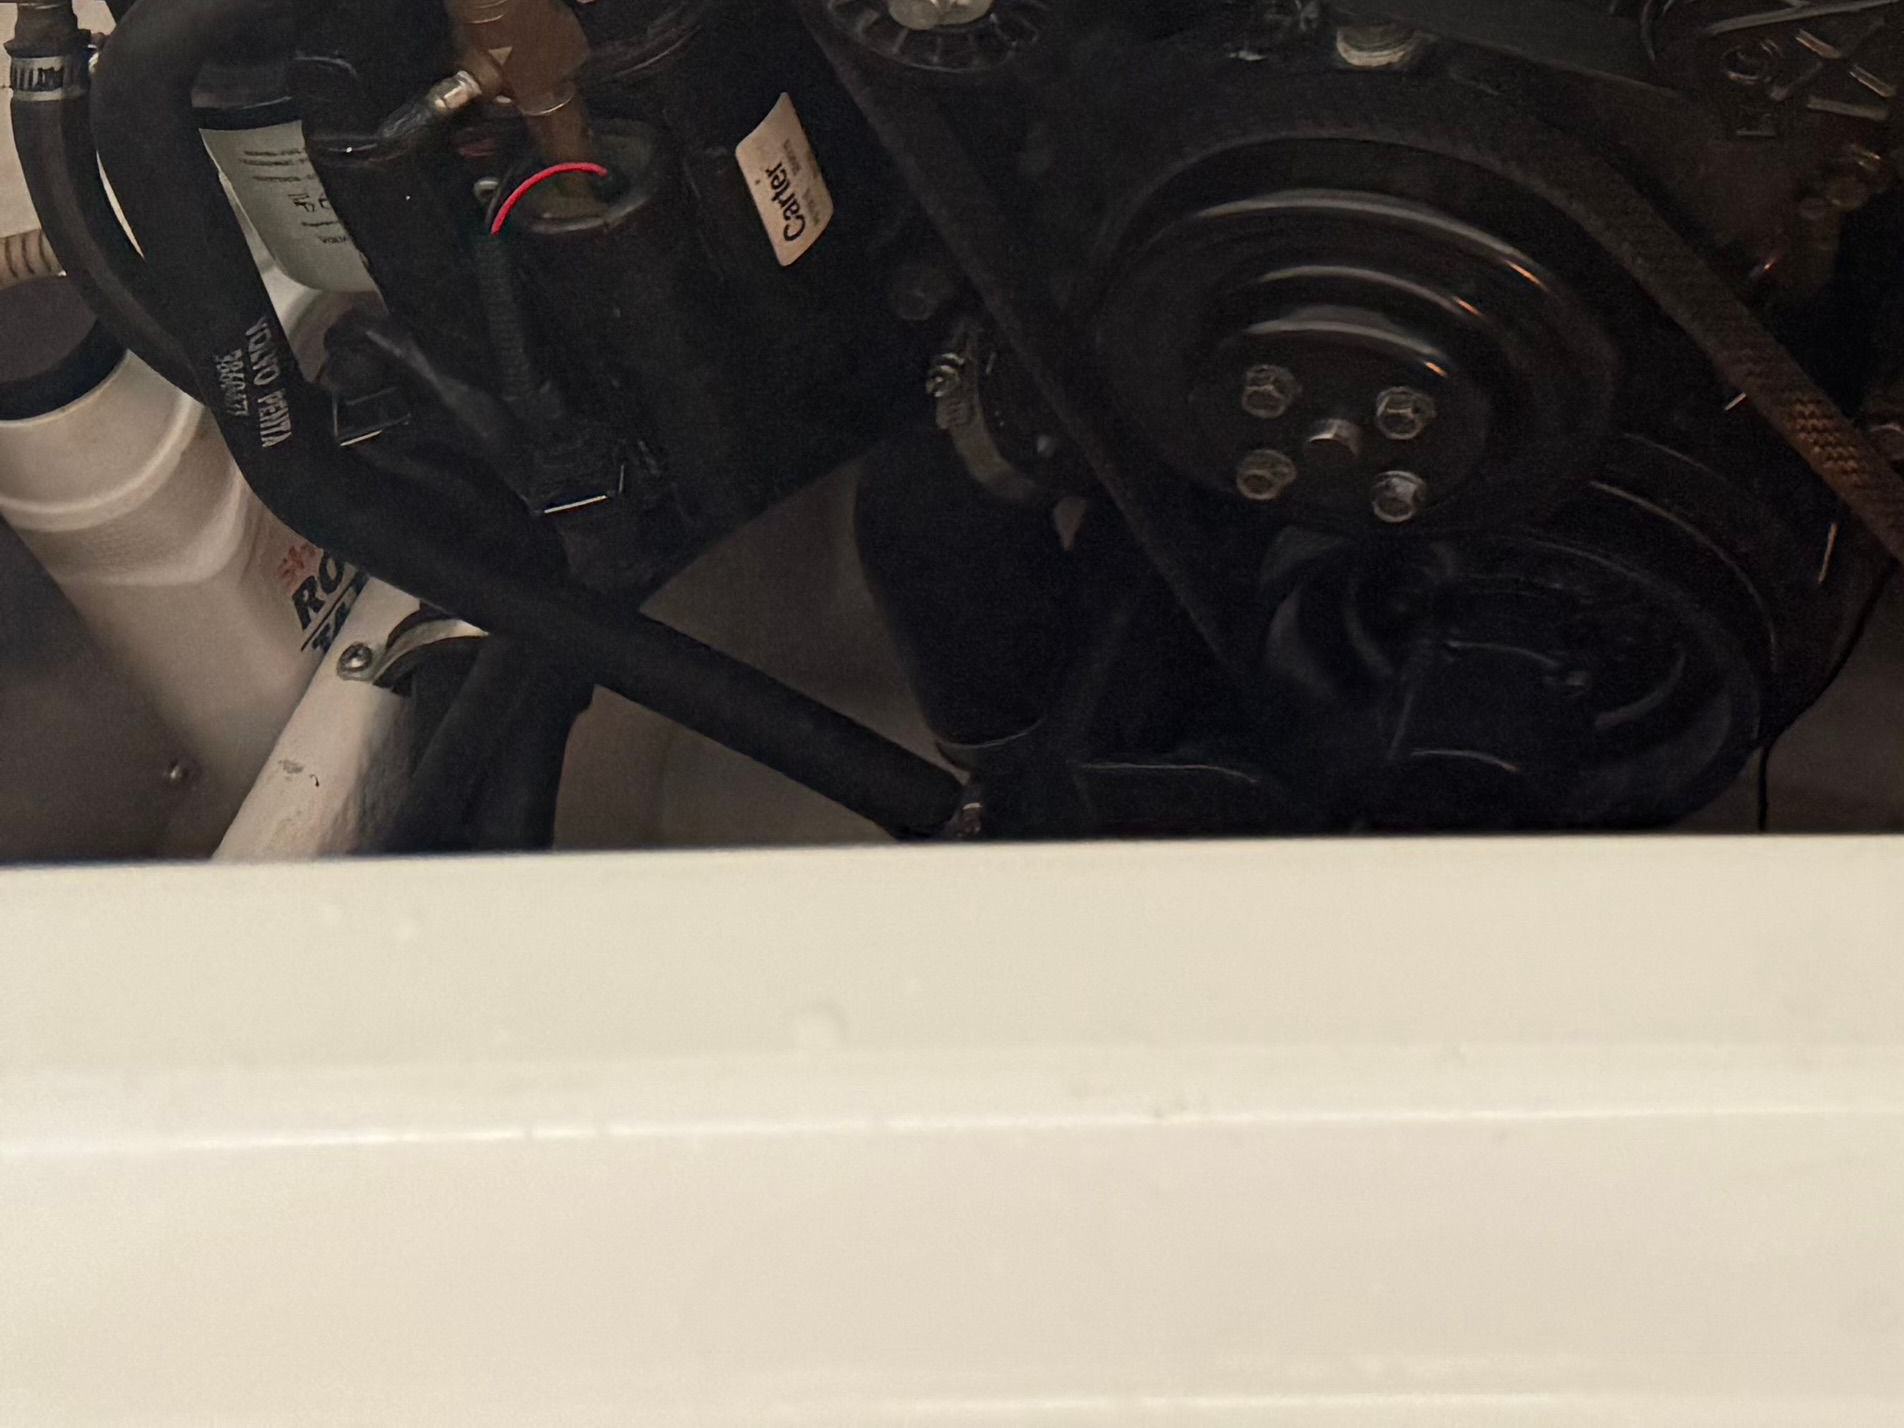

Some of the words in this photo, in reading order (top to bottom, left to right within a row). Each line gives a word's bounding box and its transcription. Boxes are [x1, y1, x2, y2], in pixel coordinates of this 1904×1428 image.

[764, 160, 806, 243] Carter
[245, 316, 281, 387] VOLVO
[257, 388, 293, 448] PENTA
